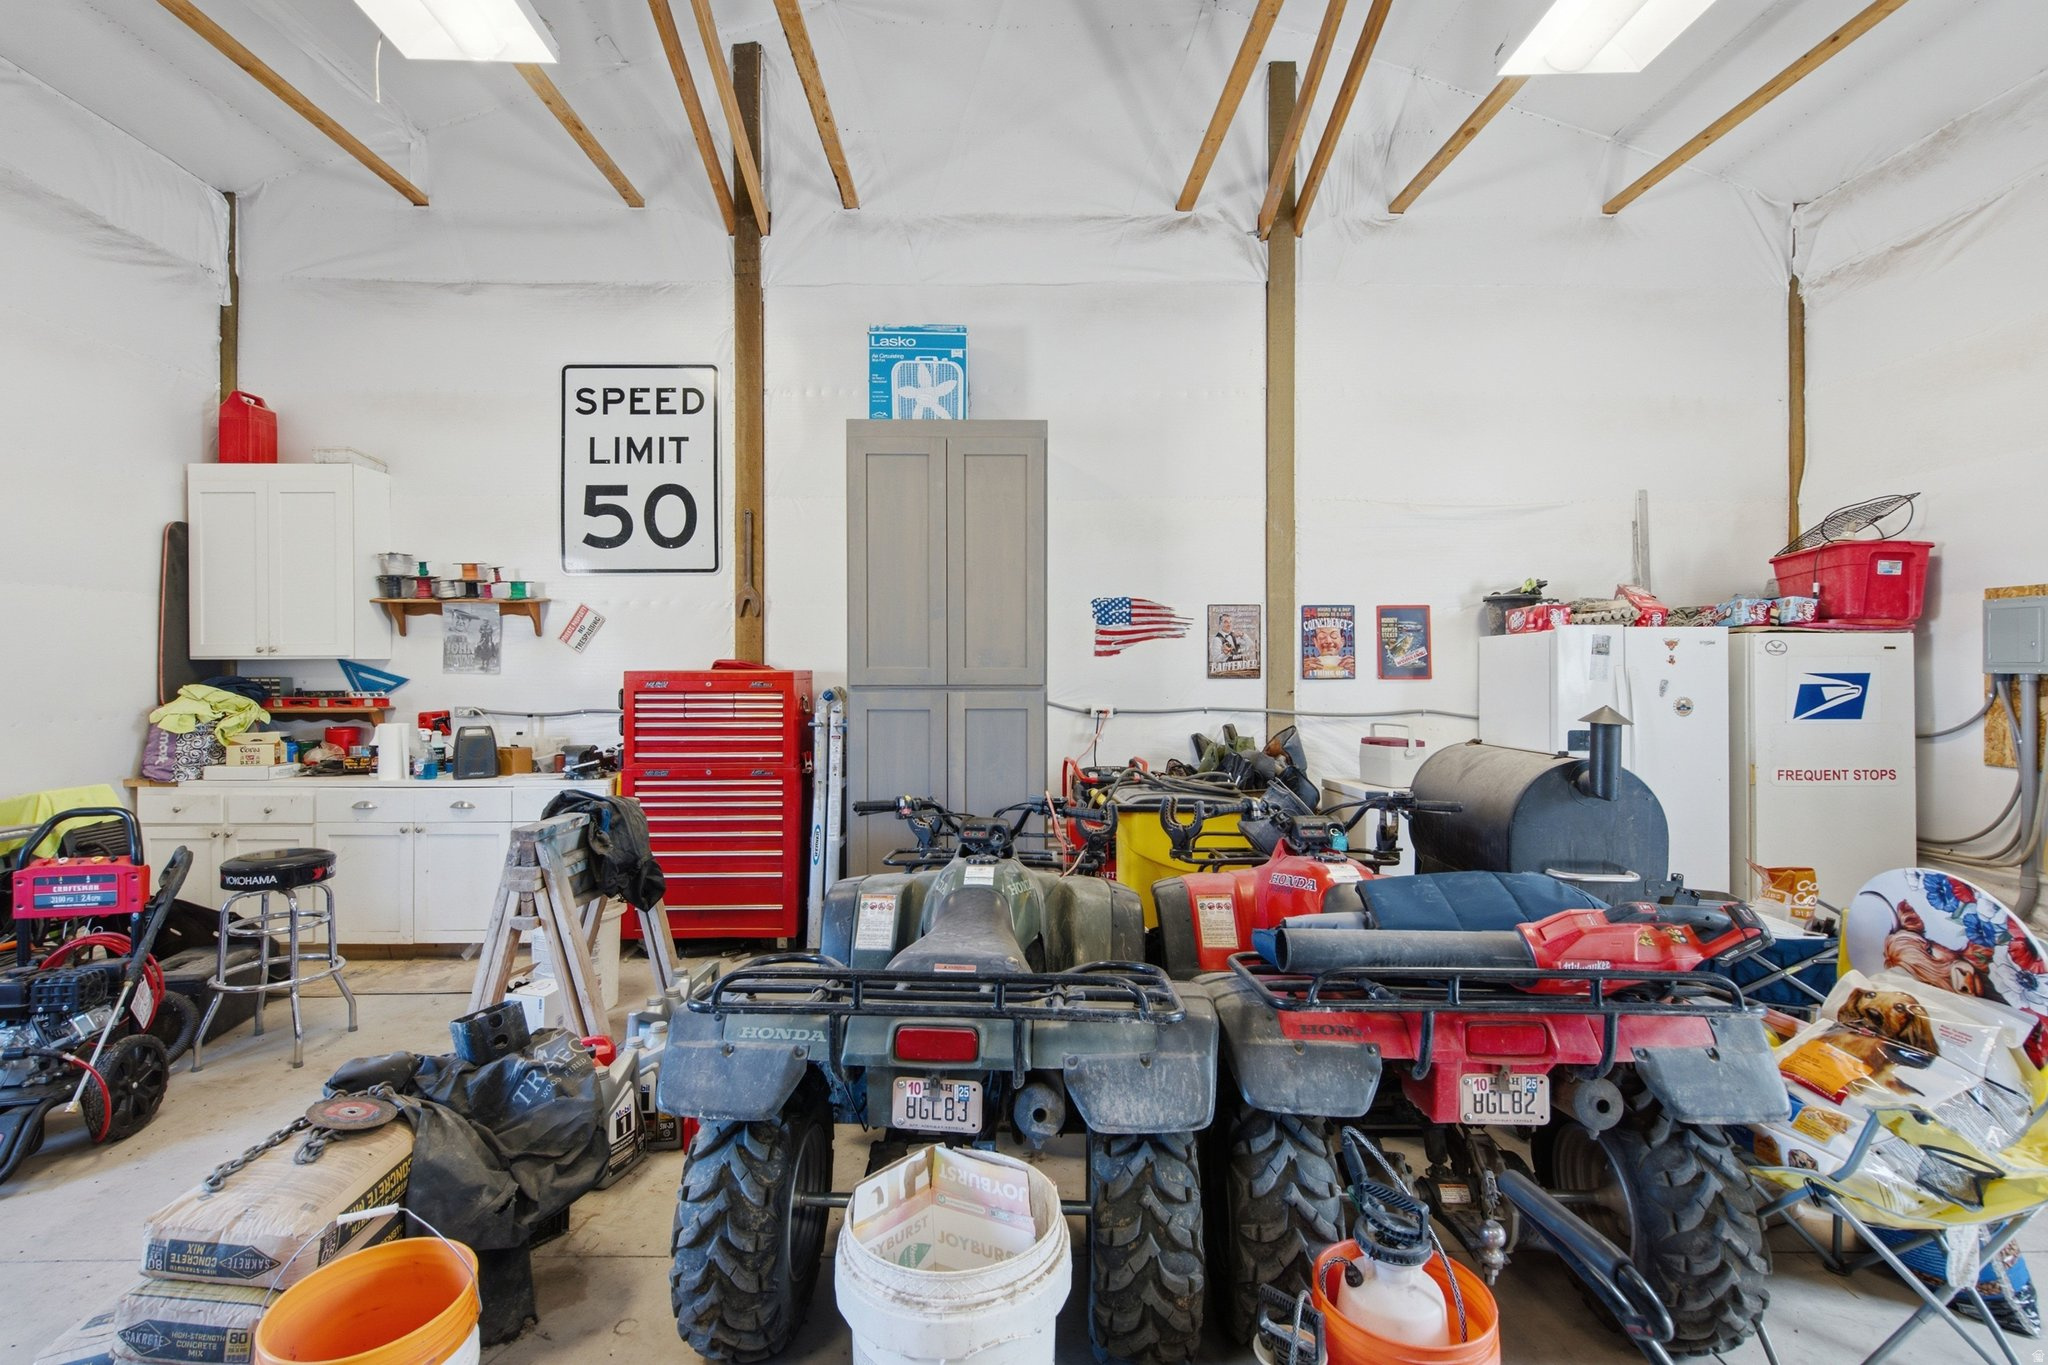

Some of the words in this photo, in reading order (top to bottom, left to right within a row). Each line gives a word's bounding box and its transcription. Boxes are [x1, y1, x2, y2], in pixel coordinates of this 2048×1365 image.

[871, 335, 917, 347] Lasko
[575, 387, 705, 415] SPEED
[589, 436, 690, 464] LIMIT
[582, 483, 698, 549] 50
[577, 624, 586, 634] NO
[1777, 769, 1849, 781] FREQUENT
[1853, 769, 1897, 781] STOPS
[225, 875, 278, 886] YOKOHAMA
[1269, 873, 1317, 892] HONDA
[52, 885, 100, 893] CRAFTSMAN
[739, 1026, 827, 1042] HONDA
[1300, 1024, 1363, 1037] HON
[540, 1077, 562, 1099] WOOD
[563, 1057, 587, 1078] FIRED
[1474, 1078, 1488, 1091] 10
[1526, 1078, 1537, 1089] 25
[640, 1084, 651, 1092] bil
[908, 1082, 921, 1095] 10
[959, 1086, 969, 1098] 25
[1473, 1090, 1536, 1114] 8GL82
[615, 1103, 632, 1119] Mobil
[938, 1162, 1028, 1202] JOYBURST
[187, 1243, 206, 1255] MIX
[937, 1230, 1015, 1261] JOYBURS
[170, 1252, 218, 1268] CONCRETE
[225, 1257, 271, 1270] SAKRETE
[124, 1330, 165, 1347] SAKRETE
[171, 1331, 226, 1342] HIGH-STRENGTH
[229, 1332, 248, 1345] 80
[176, 1340, 217, 1351] CONCRETE
[187, 1349, 203, 1358] MIX
